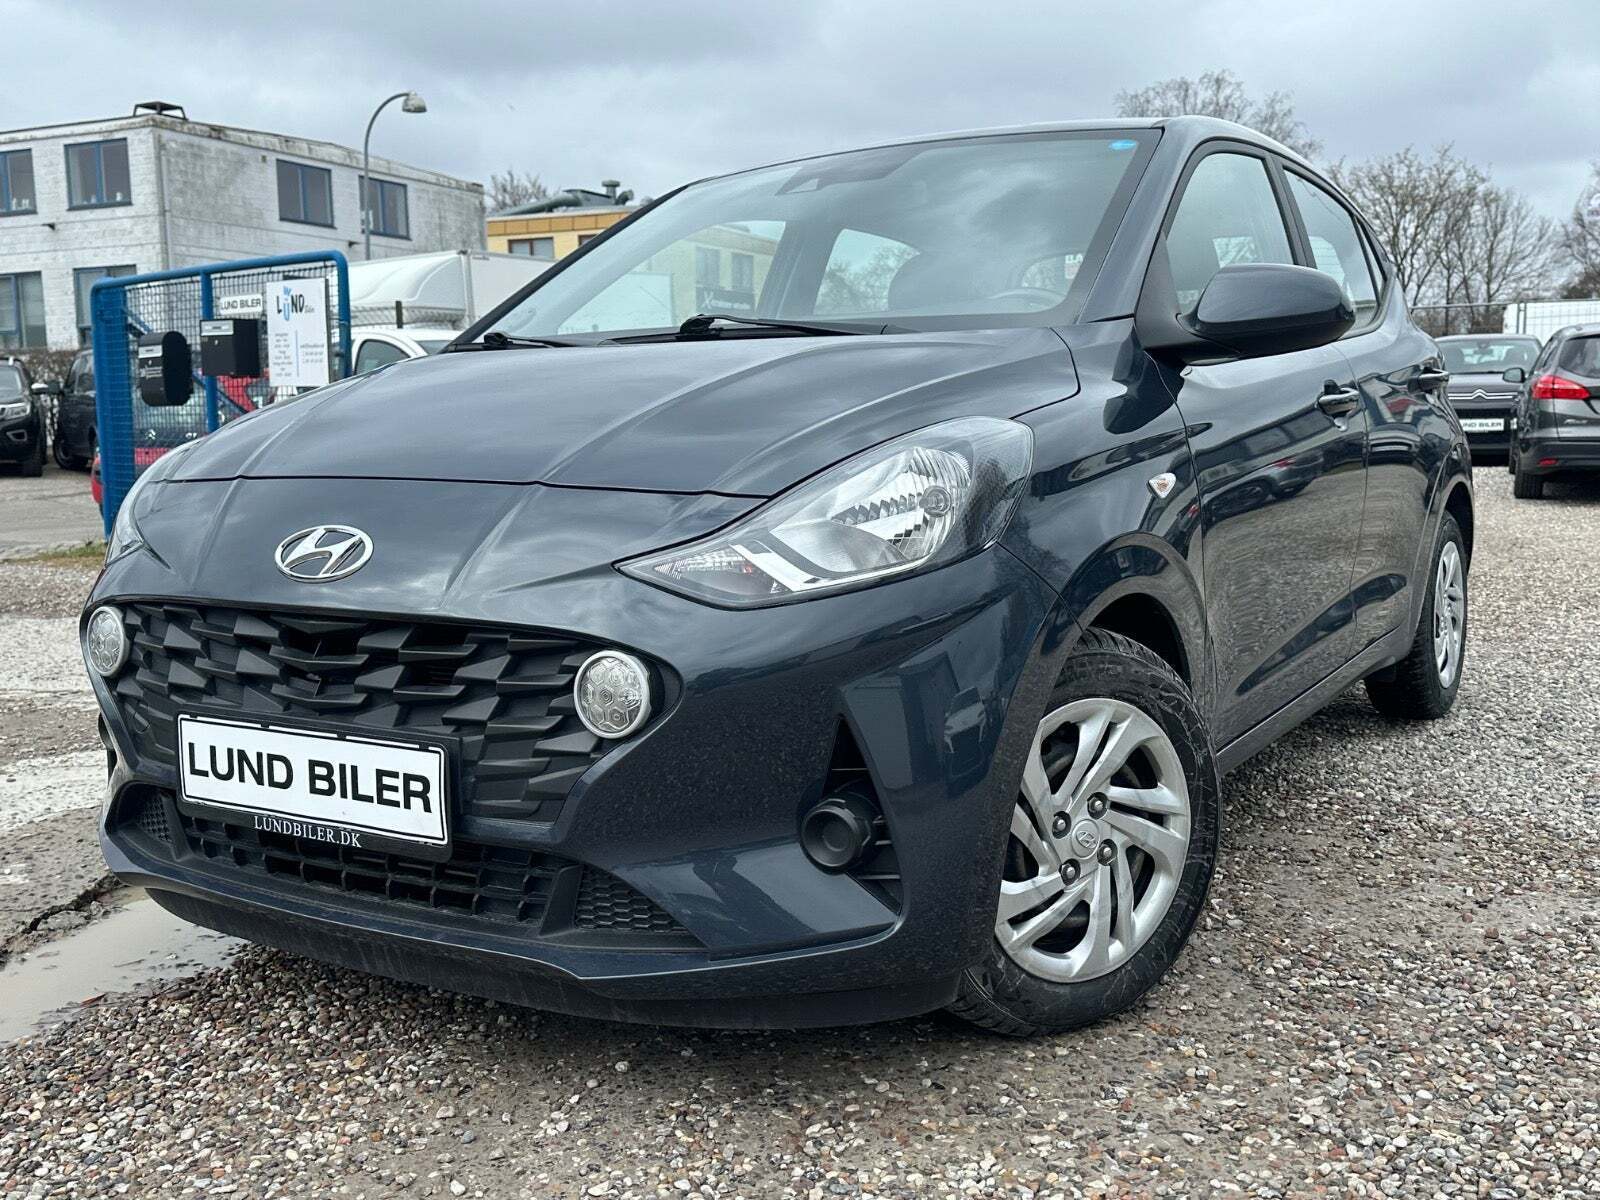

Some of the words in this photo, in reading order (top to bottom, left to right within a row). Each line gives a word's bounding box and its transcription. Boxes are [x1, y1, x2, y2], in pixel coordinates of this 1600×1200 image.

[220, 300, 238, 310] LUND
[239, 298, 261, 308] BILER
[276, 293, 305, 321] LUND
[1479, 421, 1502, 429] BILER
[188, 742, 294, 790] LUND
[308, 759, 433, 813] BILER
[254, 815, 362, 849] LUNDBILER.DK
